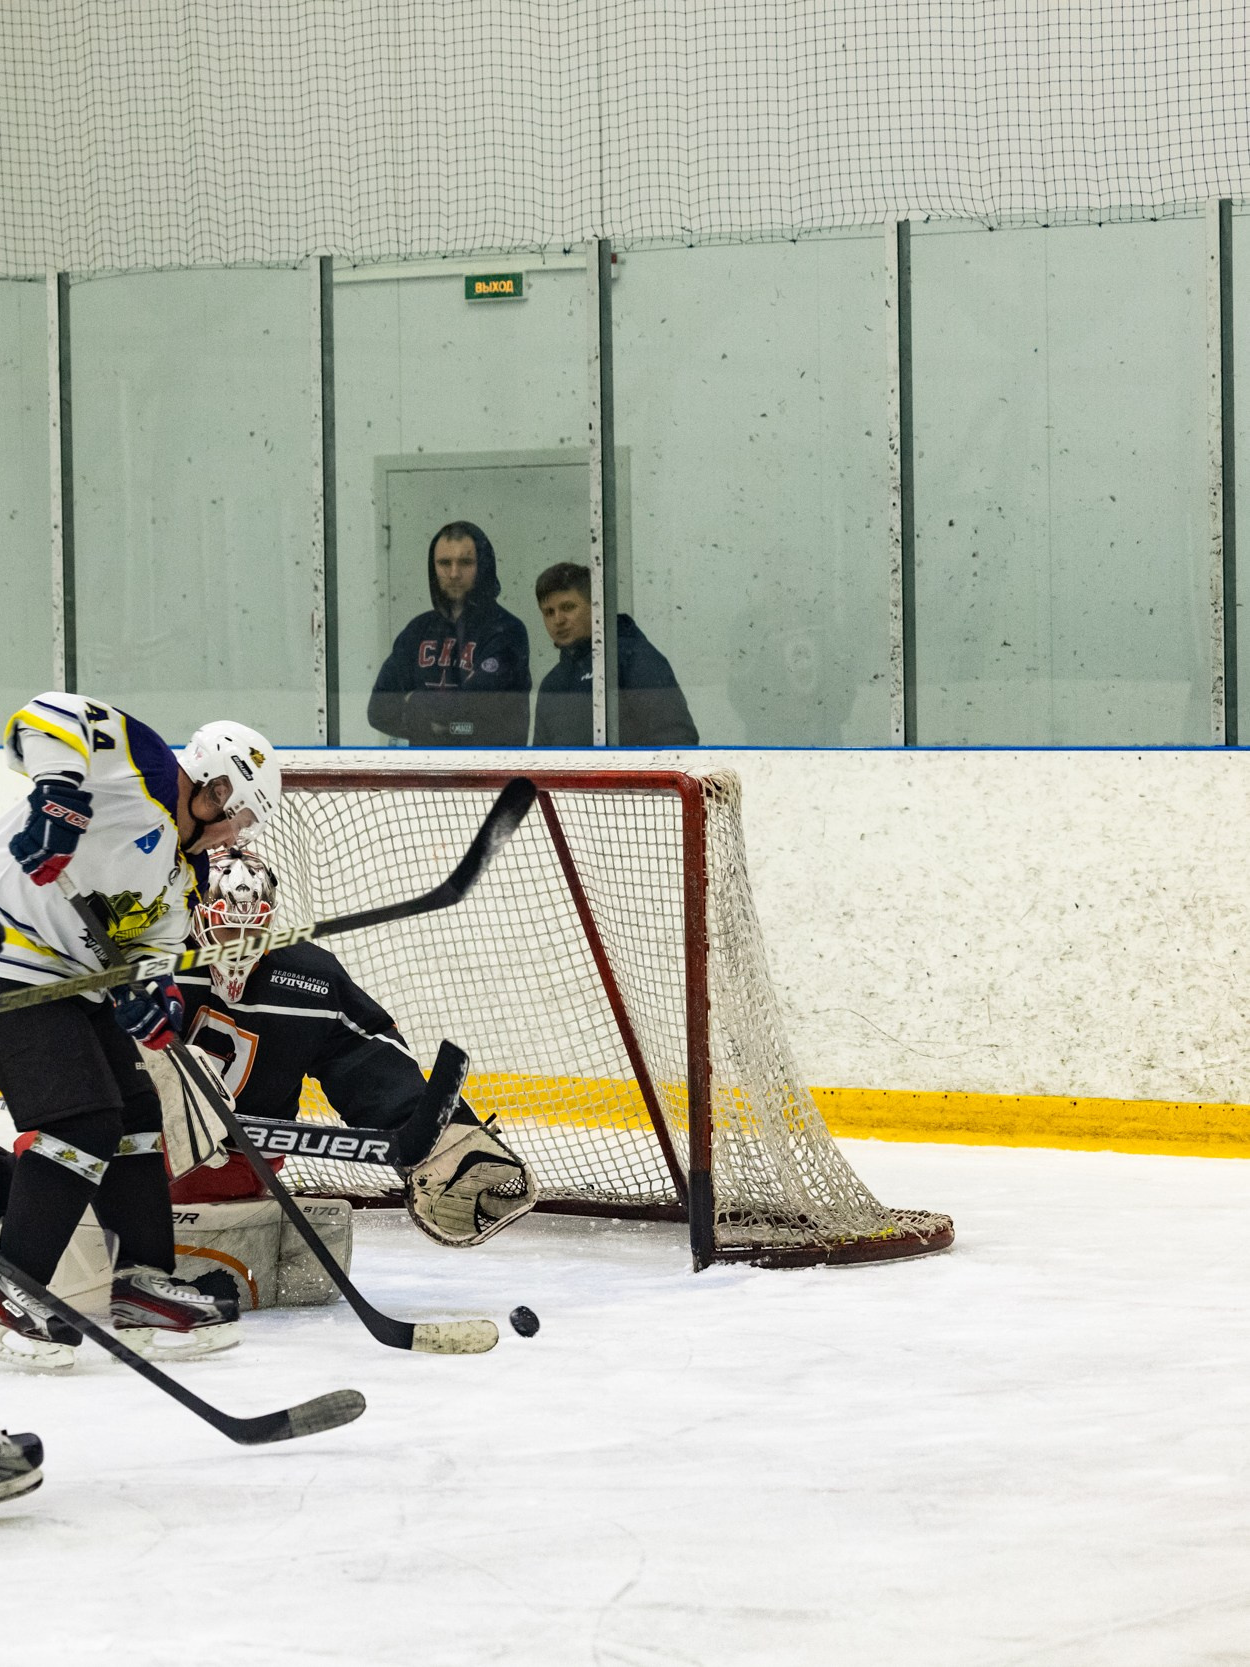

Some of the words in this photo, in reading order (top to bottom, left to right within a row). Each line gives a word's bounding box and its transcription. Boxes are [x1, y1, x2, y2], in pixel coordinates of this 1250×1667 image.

[474, 280, 514, 294] ВЫХОД
[84, 700, 116, 752] 44
[270, 974, 329, 995] КУПЧИНО
[272, 969, 306, 981] ЛЕДОВАЯ
[307, 977, 330, 988] АРЕНА
